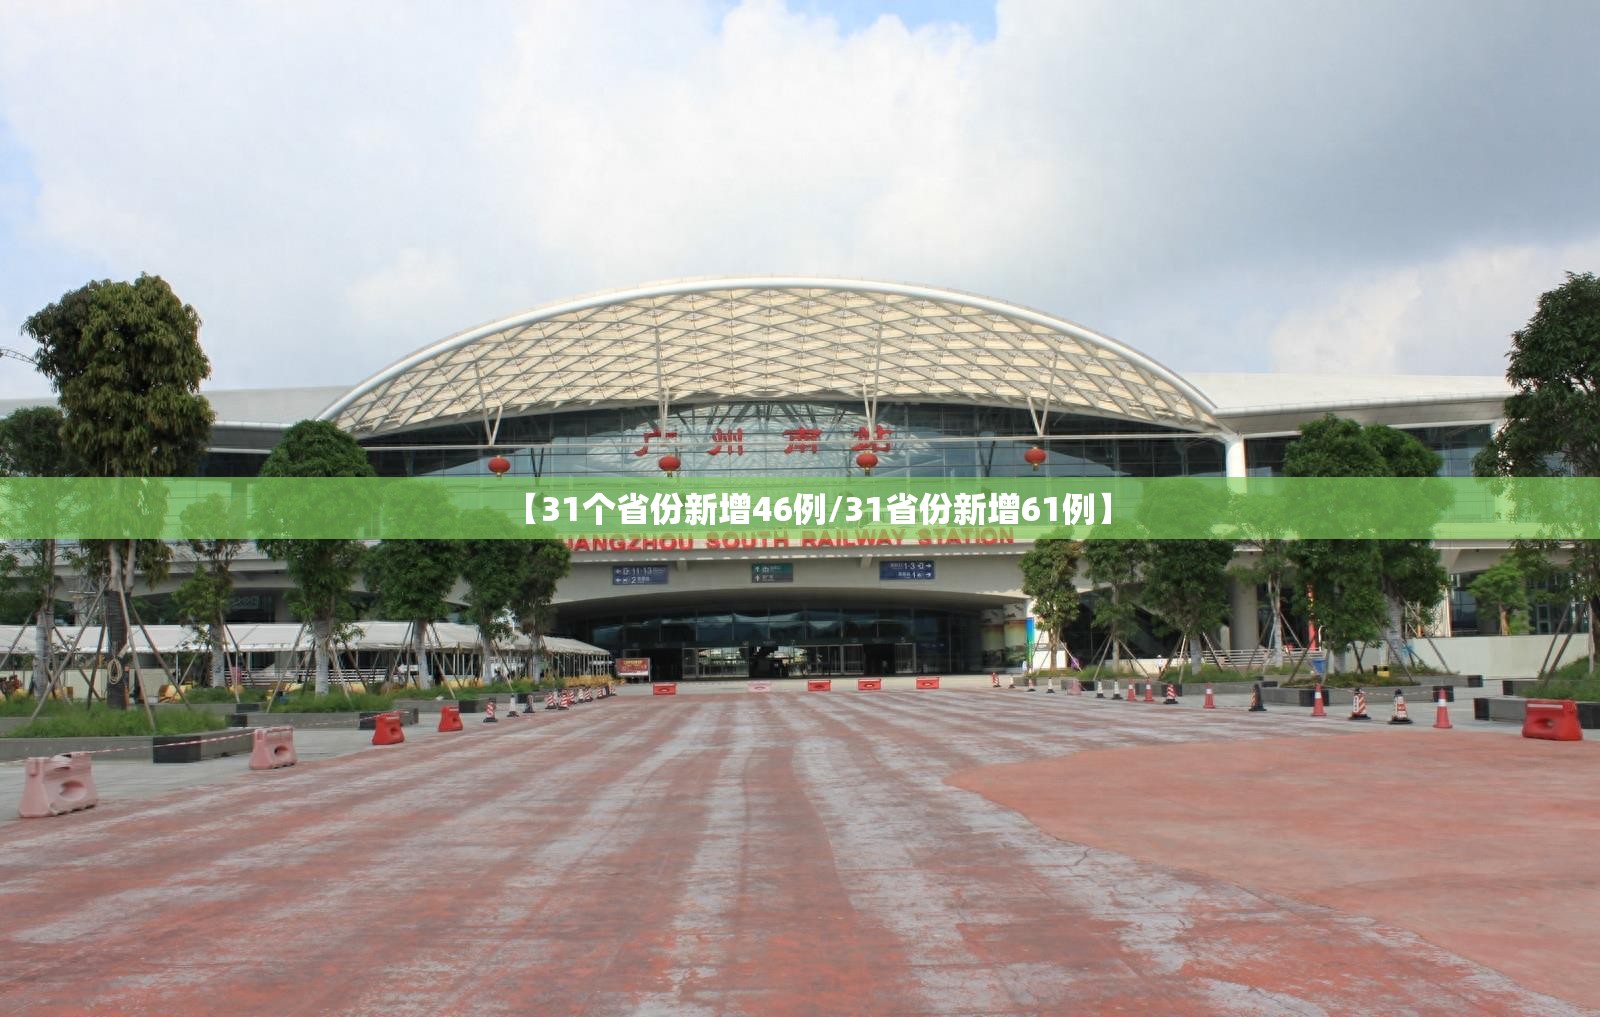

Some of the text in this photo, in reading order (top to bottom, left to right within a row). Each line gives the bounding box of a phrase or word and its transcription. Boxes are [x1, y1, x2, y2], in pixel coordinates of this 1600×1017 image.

[706, 530, 789, 550] SOUTH
[801, 528, 905, 548] RAILWAY
[917, 527, 1015, 546] STATION
